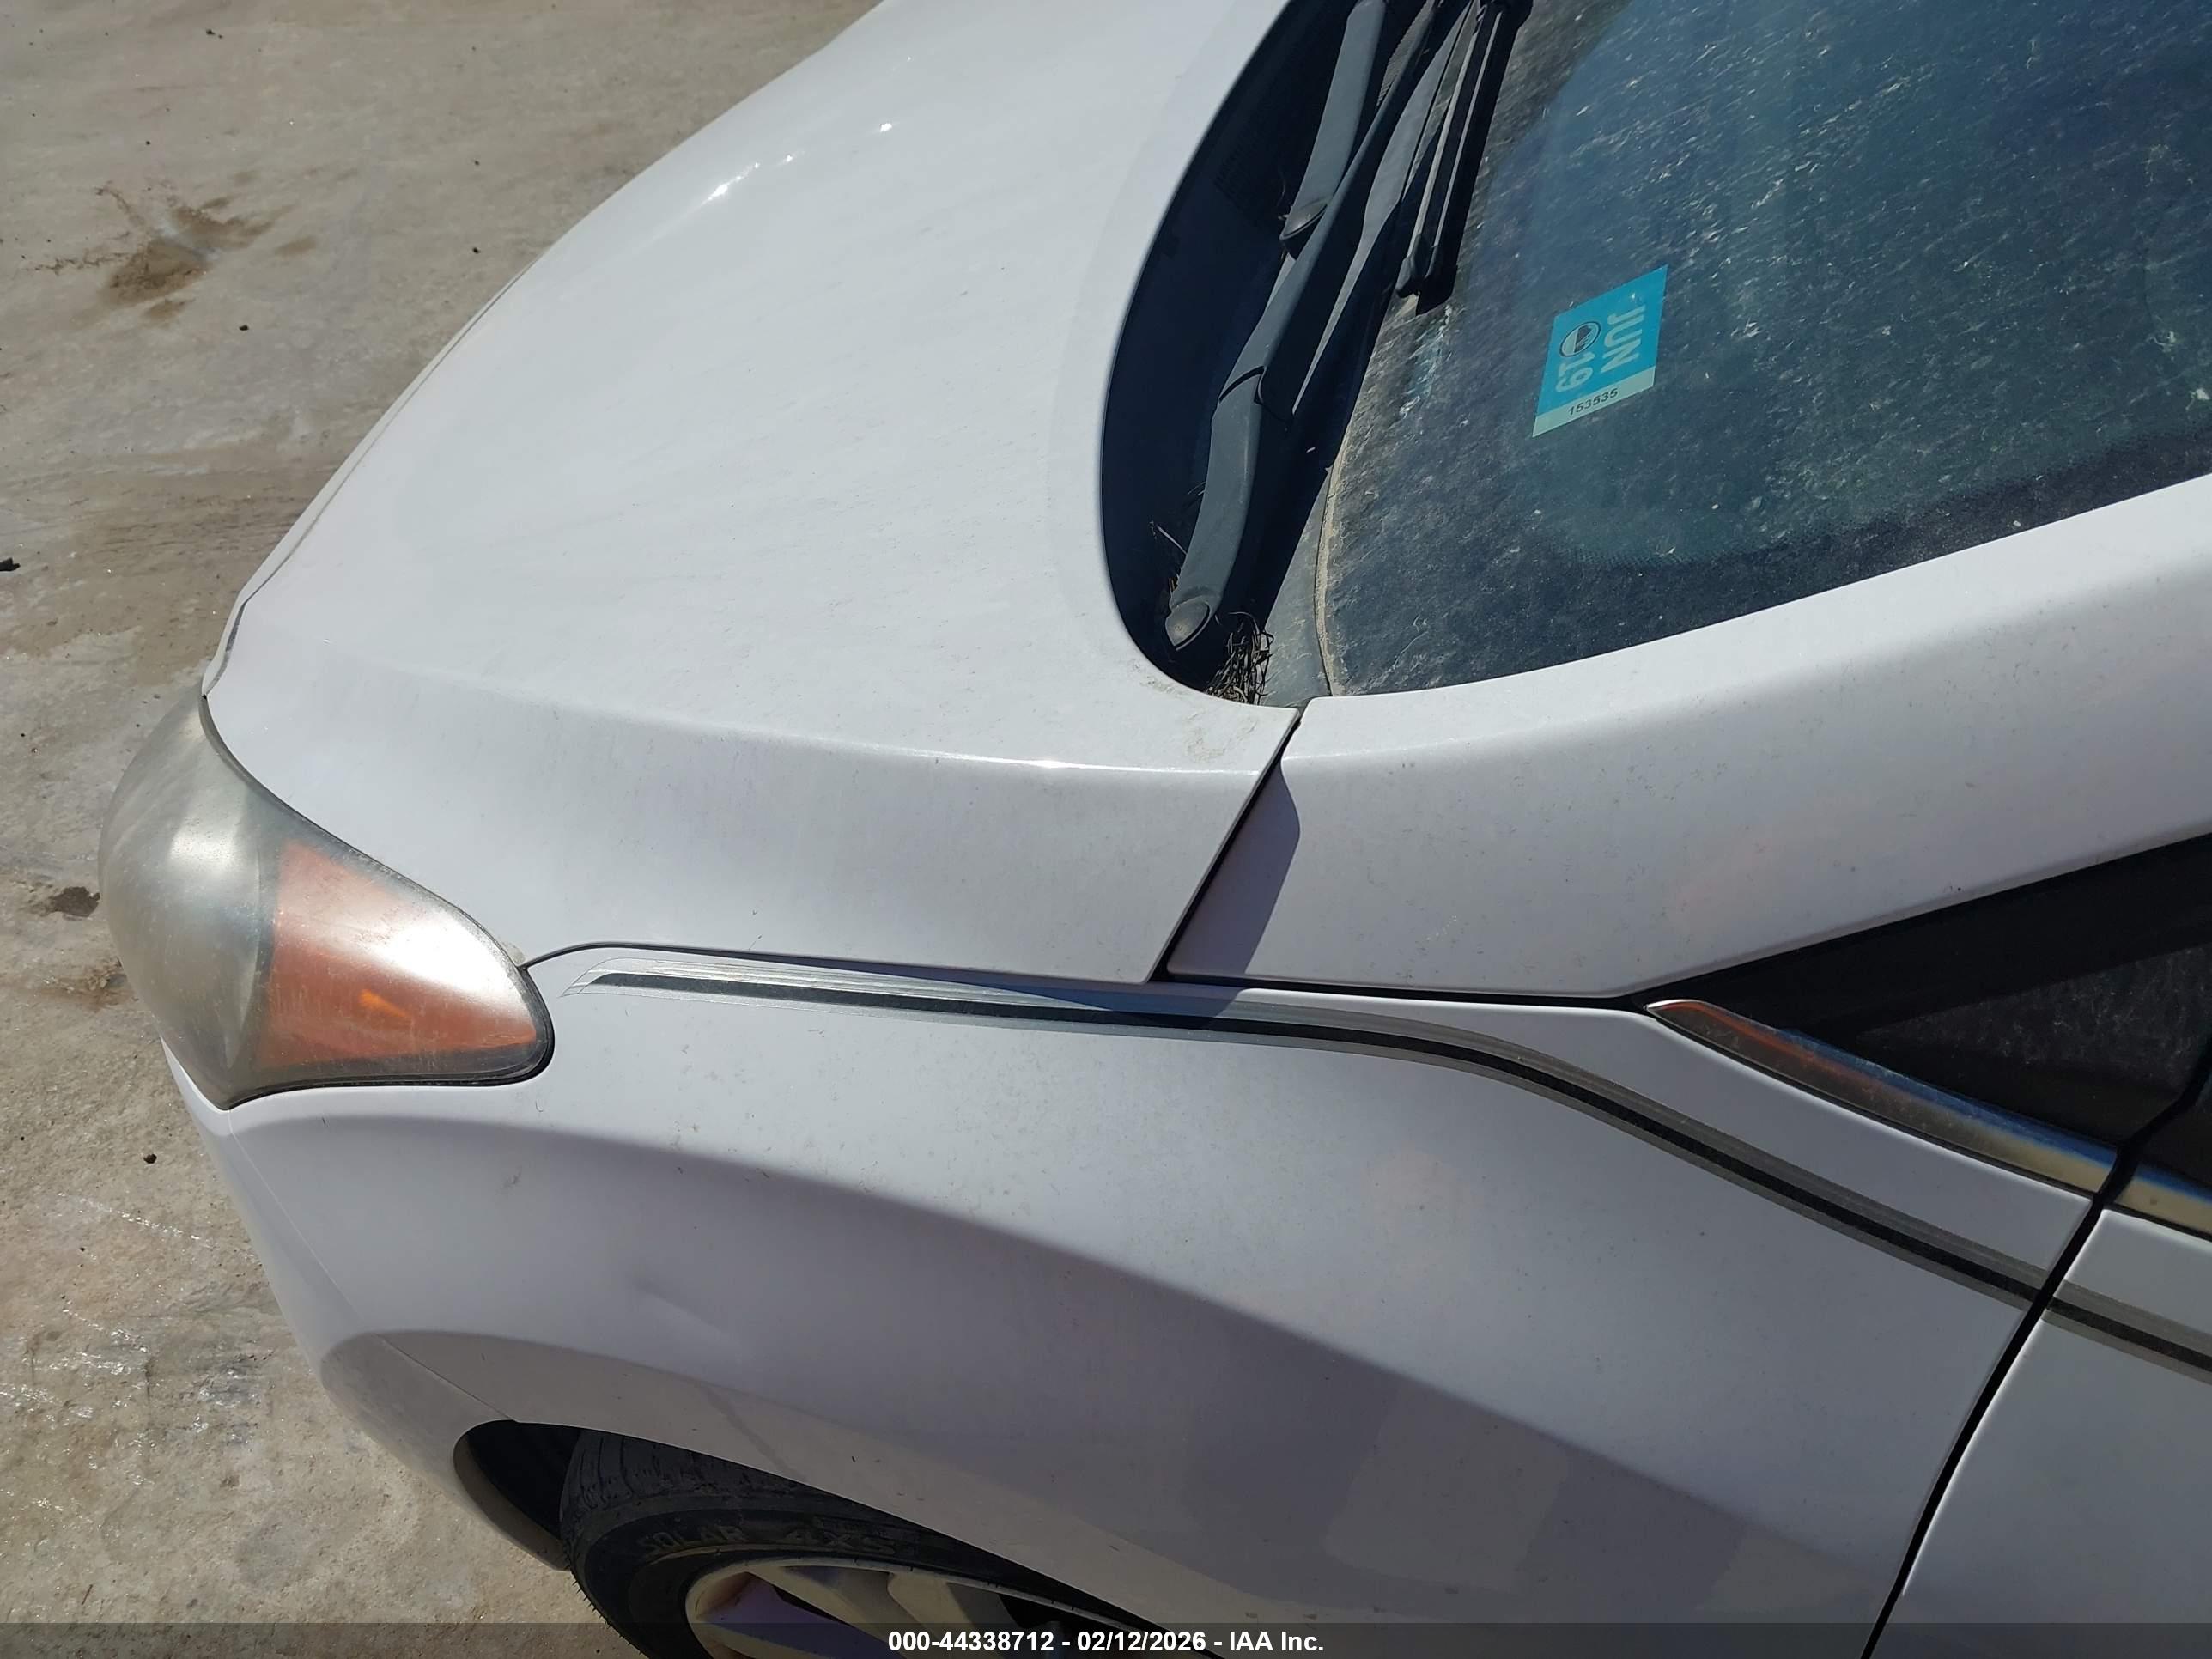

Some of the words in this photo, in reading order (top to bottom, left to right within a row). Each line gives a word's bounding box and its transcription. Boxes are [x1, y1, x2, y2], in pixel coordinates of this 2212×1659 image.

[1600, 304, 1647, 374] JUN
[1555, 352, 1596, 392] 19
[1567, 387, 1620, 416] 153535
